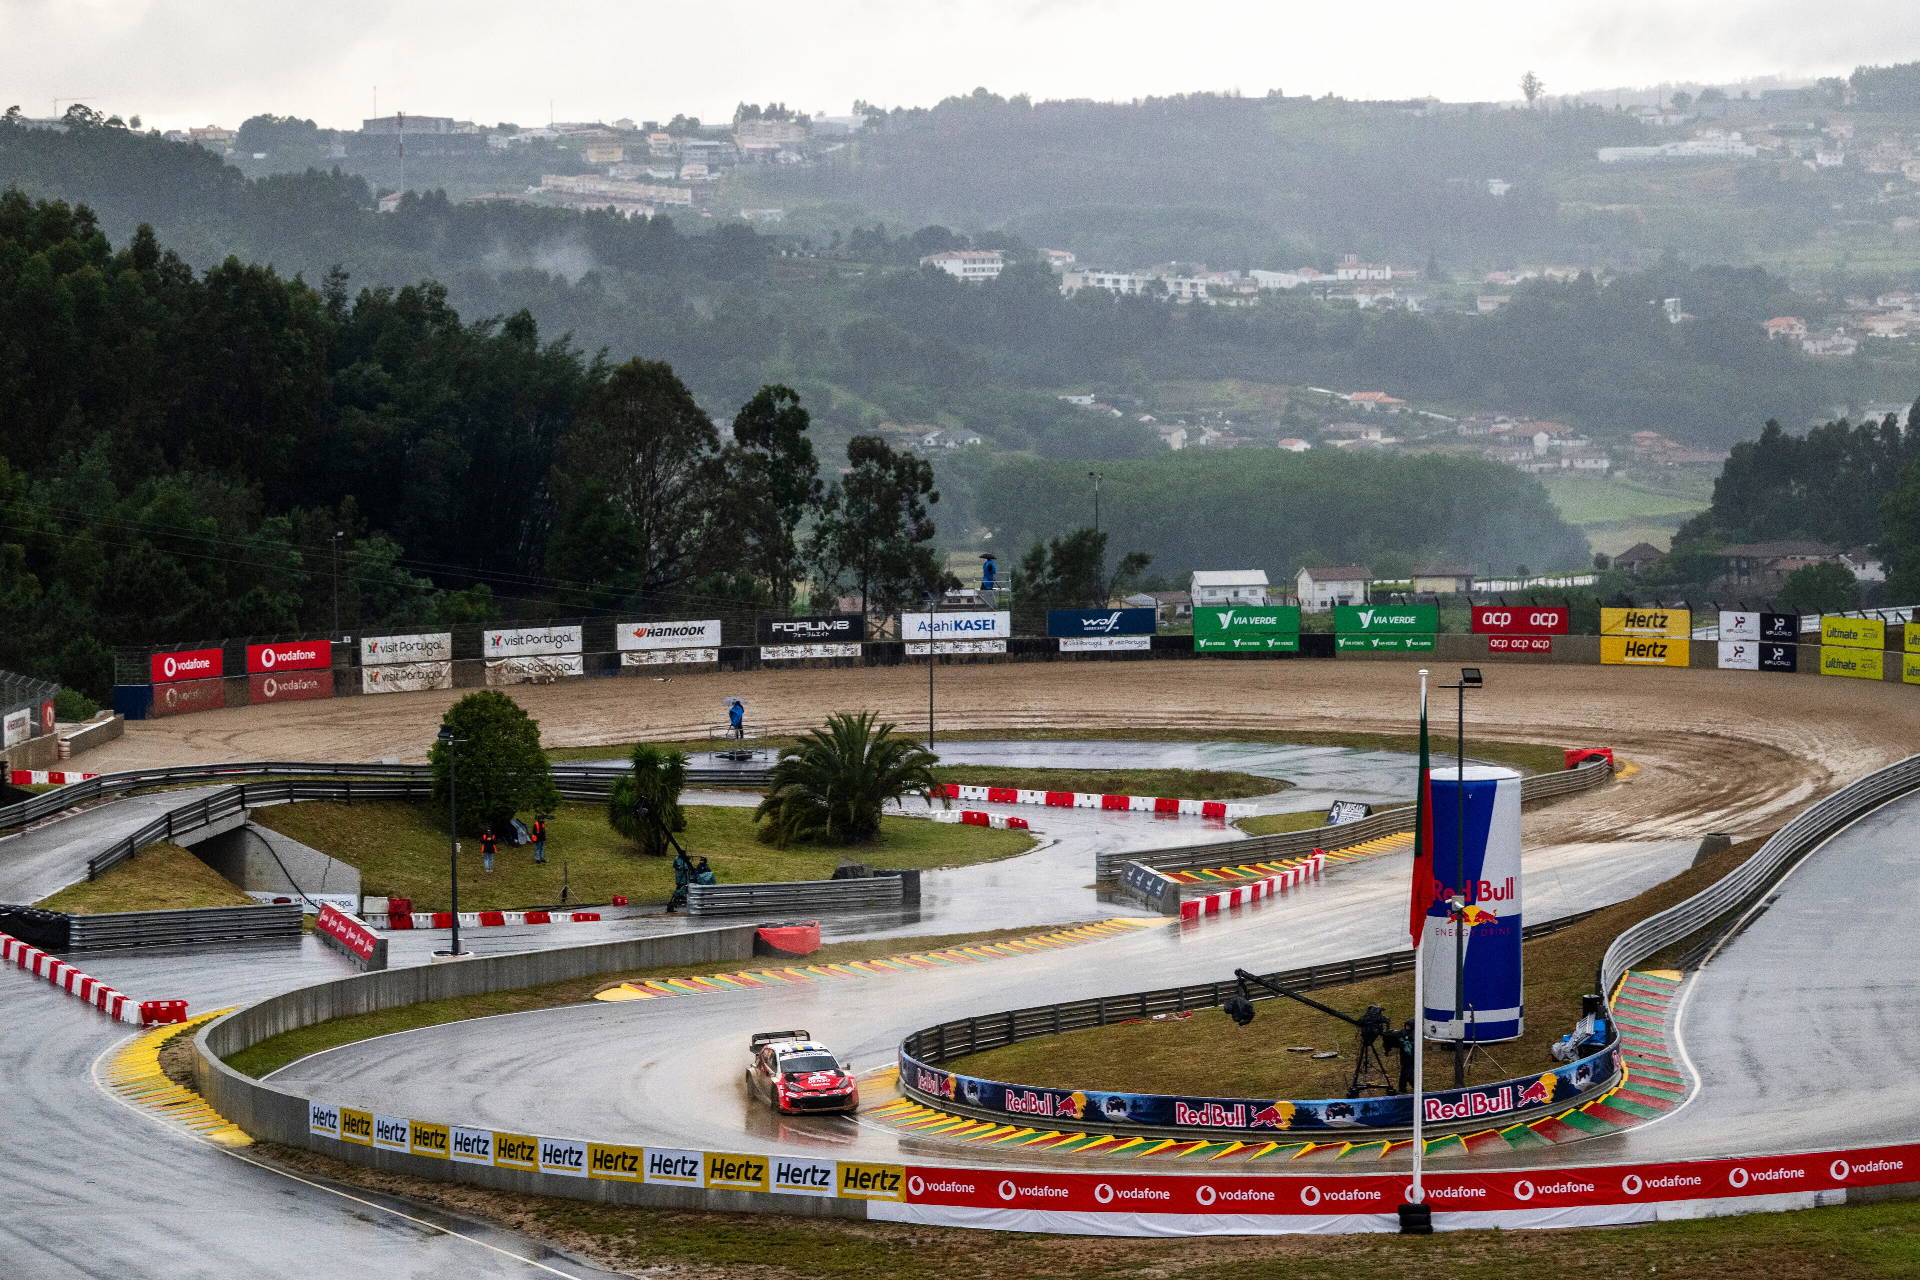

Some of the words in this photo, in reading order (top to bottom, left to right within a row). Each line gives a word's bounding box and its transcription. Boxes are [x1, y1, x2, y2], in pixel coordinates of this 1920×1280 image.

[772, 620, 849, 632] FORUM8
[1233, 617, 1248, 625] VIA
[1249, 617, 1278, 625] VERDE
[1373, 616, 1388, 624] VIA
[1389, 616, 1416, 624] VERDE
[1482, 612, 1511, 627] acp
[1530, 613, 1559, 628] acp
[1625, 612, 1668, 628] Hertz
[504, 635, 524, 646] visit
[526, 633, 574, 648] Portugal
[1490, 639, 1508, 648] acp
[1511, 640, 1529, 649] acp
[1532, 640, 1550, 649] acp
[277, 649, 316, 662] vodafone
[379, 642, 398, 653] visit
[399, 640, 444, 657] Portugal
[1625, 641, 1668, 657] Hertz
[177, 658, 210, 671] vodafone
[527, 662, 576, 677] Portugal
[279, 679, 318, 691] vodafone
[381, 672, 399, 683] visit
[400, 670, 443, 685] Portugal
[1434, 880, 1472, 902] Red
[1477, 877, 1513, 901] Bull
[1005, 1088, 1028, 1112] Red
[1028, 1091, 1053, 1116] Bull
[1424, 1094, 1470, 1121] Red
[1471, 1087, 1513, 1115] Bull
[312, 1106, 337, 1130] Hertz
[1176, 1101, 1210, 1126] Red
[1211, 1103, 1246, 1127] Bull
[343, 1113, 371, 1136] Hertz
[376, 1119, 406, 1143] Hertz
[413, 1126, 446, 1149] Hertz
[454, 1132, 490, 1156] Hertz
[498, 1138, 535, 1162] Hertz
[542, 1143, 583, 1167] Hertz
[592, 1149, 639, 1172] Hertz
[649, 1153, 699, 1178] Hertz
[1851, 1159, 1903, 1174] vodafone
[711, 1158, 764, 1182] Hertz
[776, 1163, 831, 1187] Hertz
[1751, 1167, 1805, 1181] vodafone
[844, 1167, 901, 1191] Hertz
[1645, 1174, 1702, 1188] vodafone
[926, 1181, 975, 1193] vodafone
[1018, 1186, 1069, 1198] vodafone
[1116, 1188, 1171, 1200] vodafone
[1323, 1188, 1381, 1201] vodafone
[1428, 1185, 1486, 1198] vodafone
[1537, 1180, 1594, 1195] vodafone
[1219, 1189, 1275, 1201] vodafone
